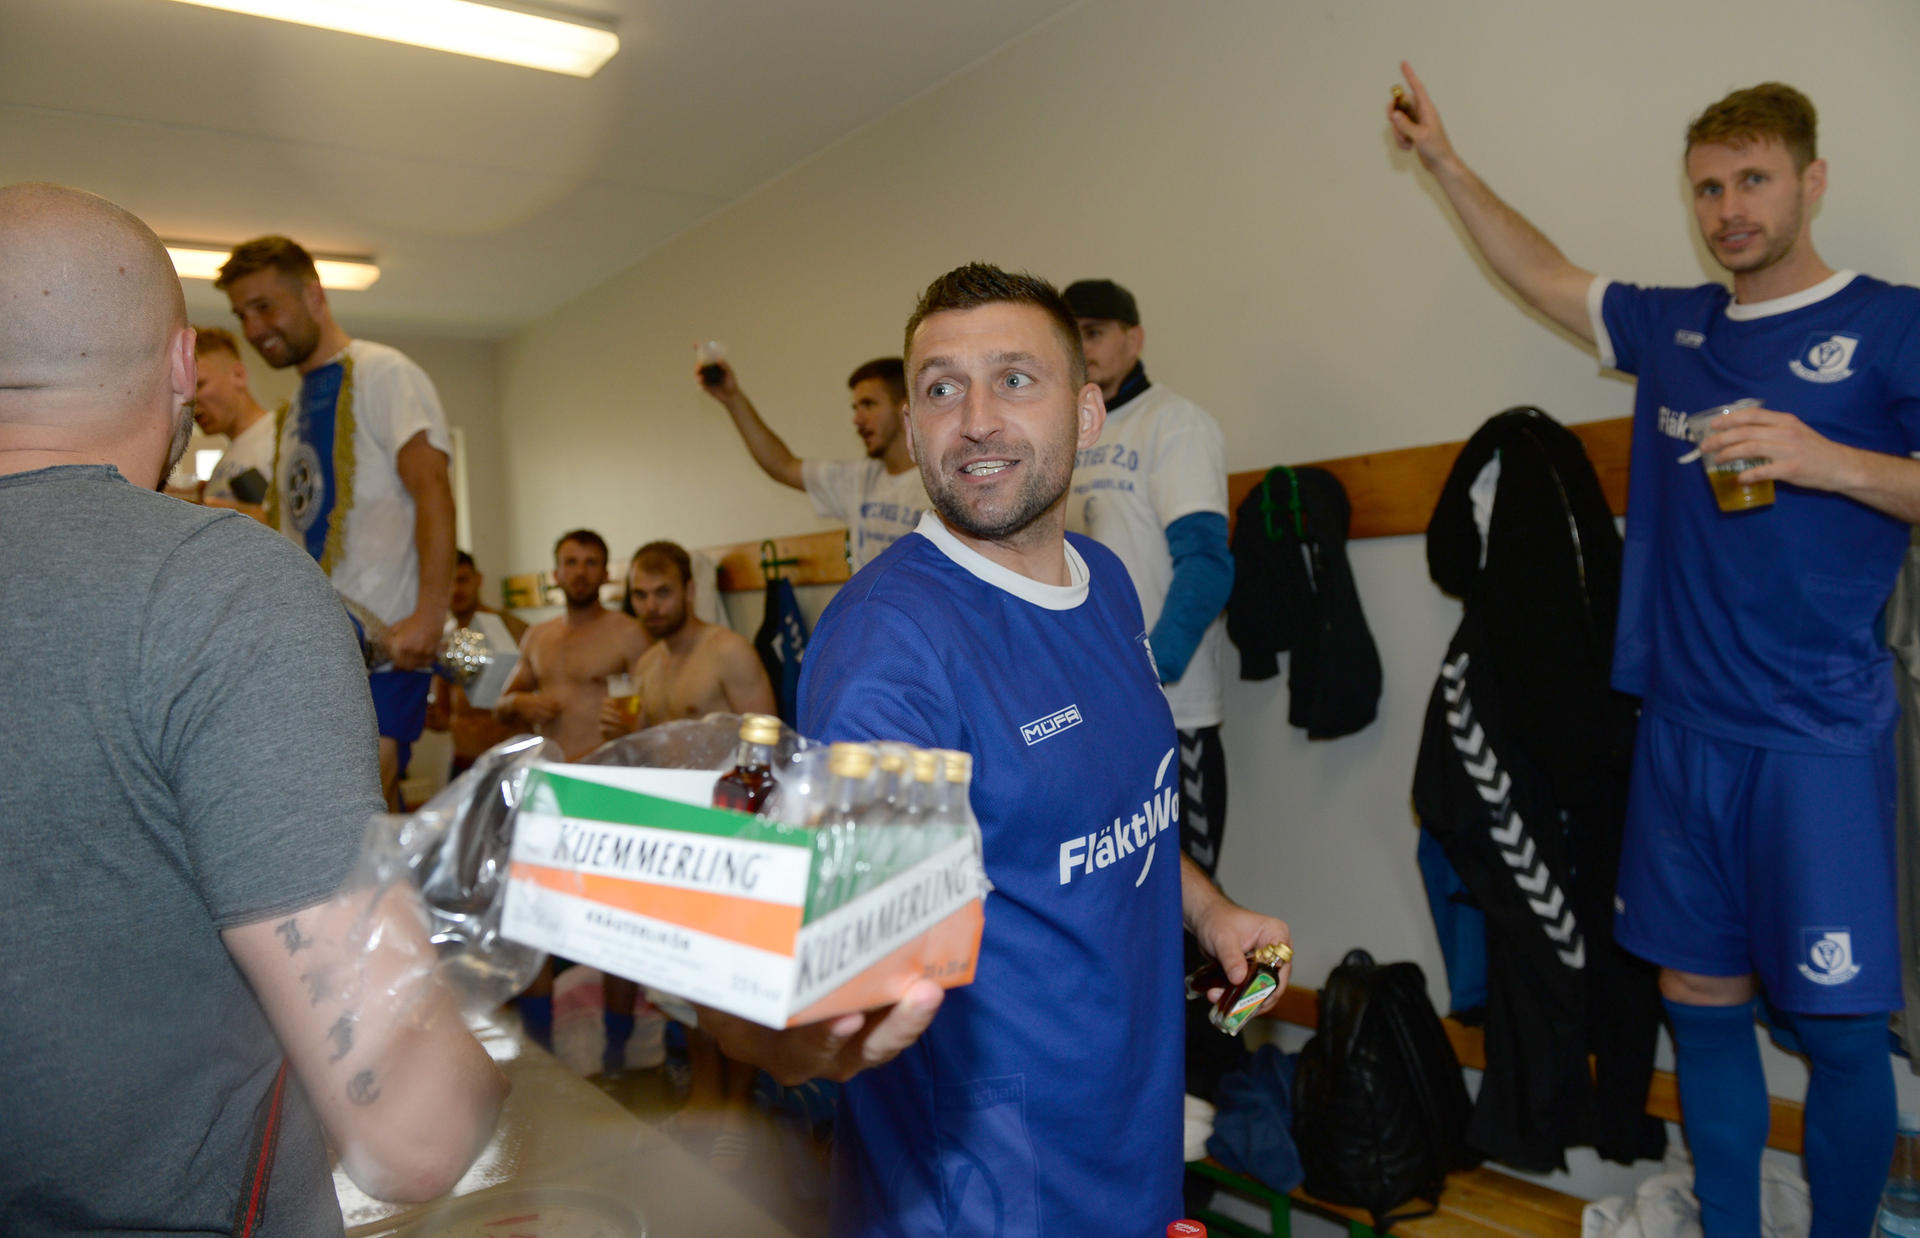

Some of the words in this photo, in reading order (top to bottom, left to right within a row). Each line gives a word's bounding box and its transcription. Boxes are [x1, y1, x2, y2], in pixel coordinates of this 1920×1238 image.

[1111, 443, 1139, 471] 2.0
[1024, 708, 1080, 742] MÜFA
[553, 823, 762, 890] KUEMMERLING
